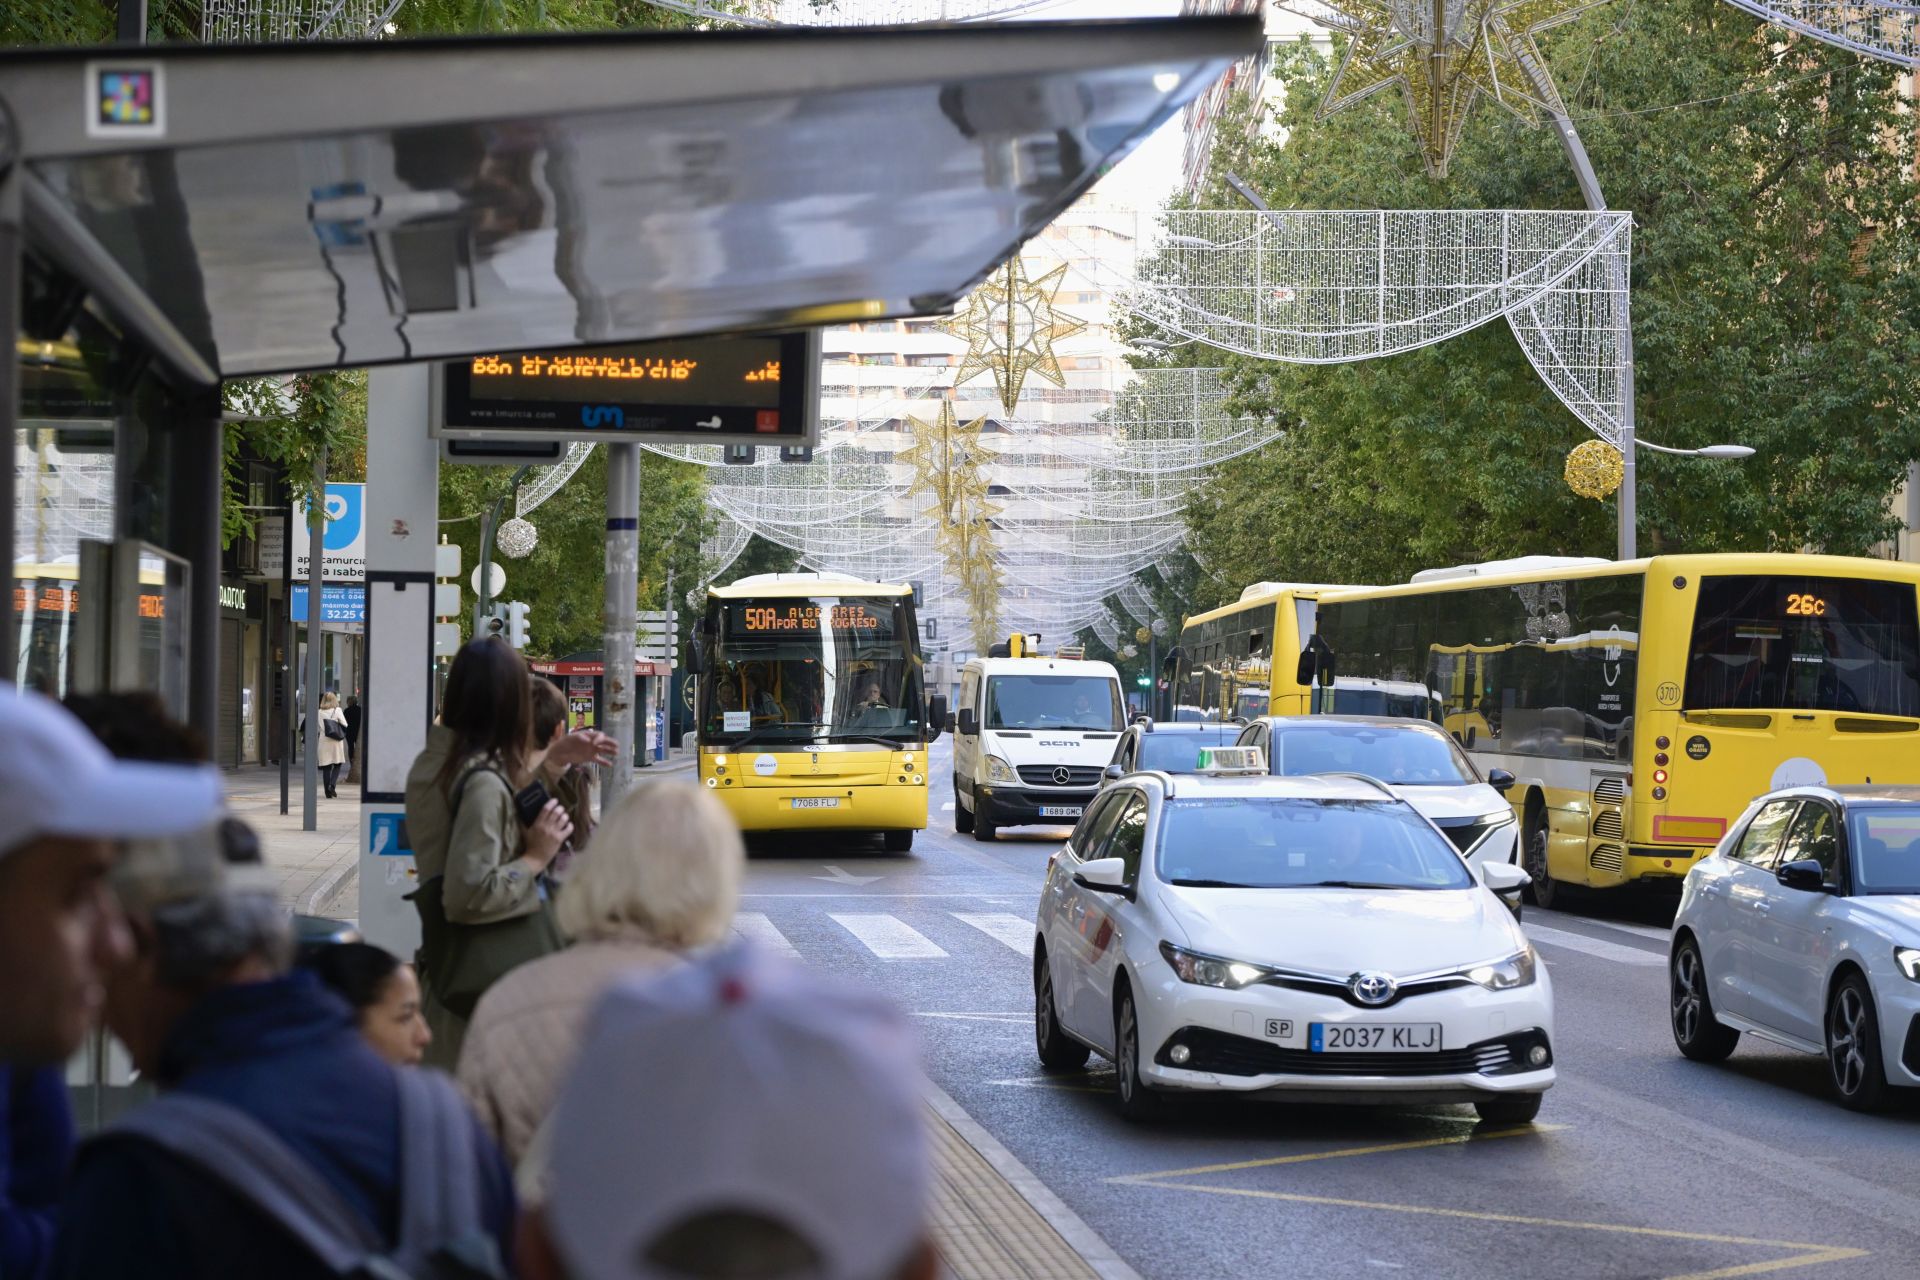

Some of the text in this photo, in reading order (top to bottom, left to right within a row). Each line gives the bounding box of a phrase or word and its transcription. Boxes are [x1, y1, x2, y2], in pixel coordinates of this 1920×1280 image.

[470, 408, 556, 419] www.tmurcia.com
[327, 610, 356, 619] 32.25
[789, 606, 865, 618] ALGEARES
[745, 608, 776, 630] 50A
[777, 618, 798, 629] POR
[797, 798, 838, 808] 7068 FLJ
[1269, 1022, 1289, 1035] SP
[1328, 1027, 1384, 1048] 2037
[1392, 1027, 1435, 1048] KLJ
